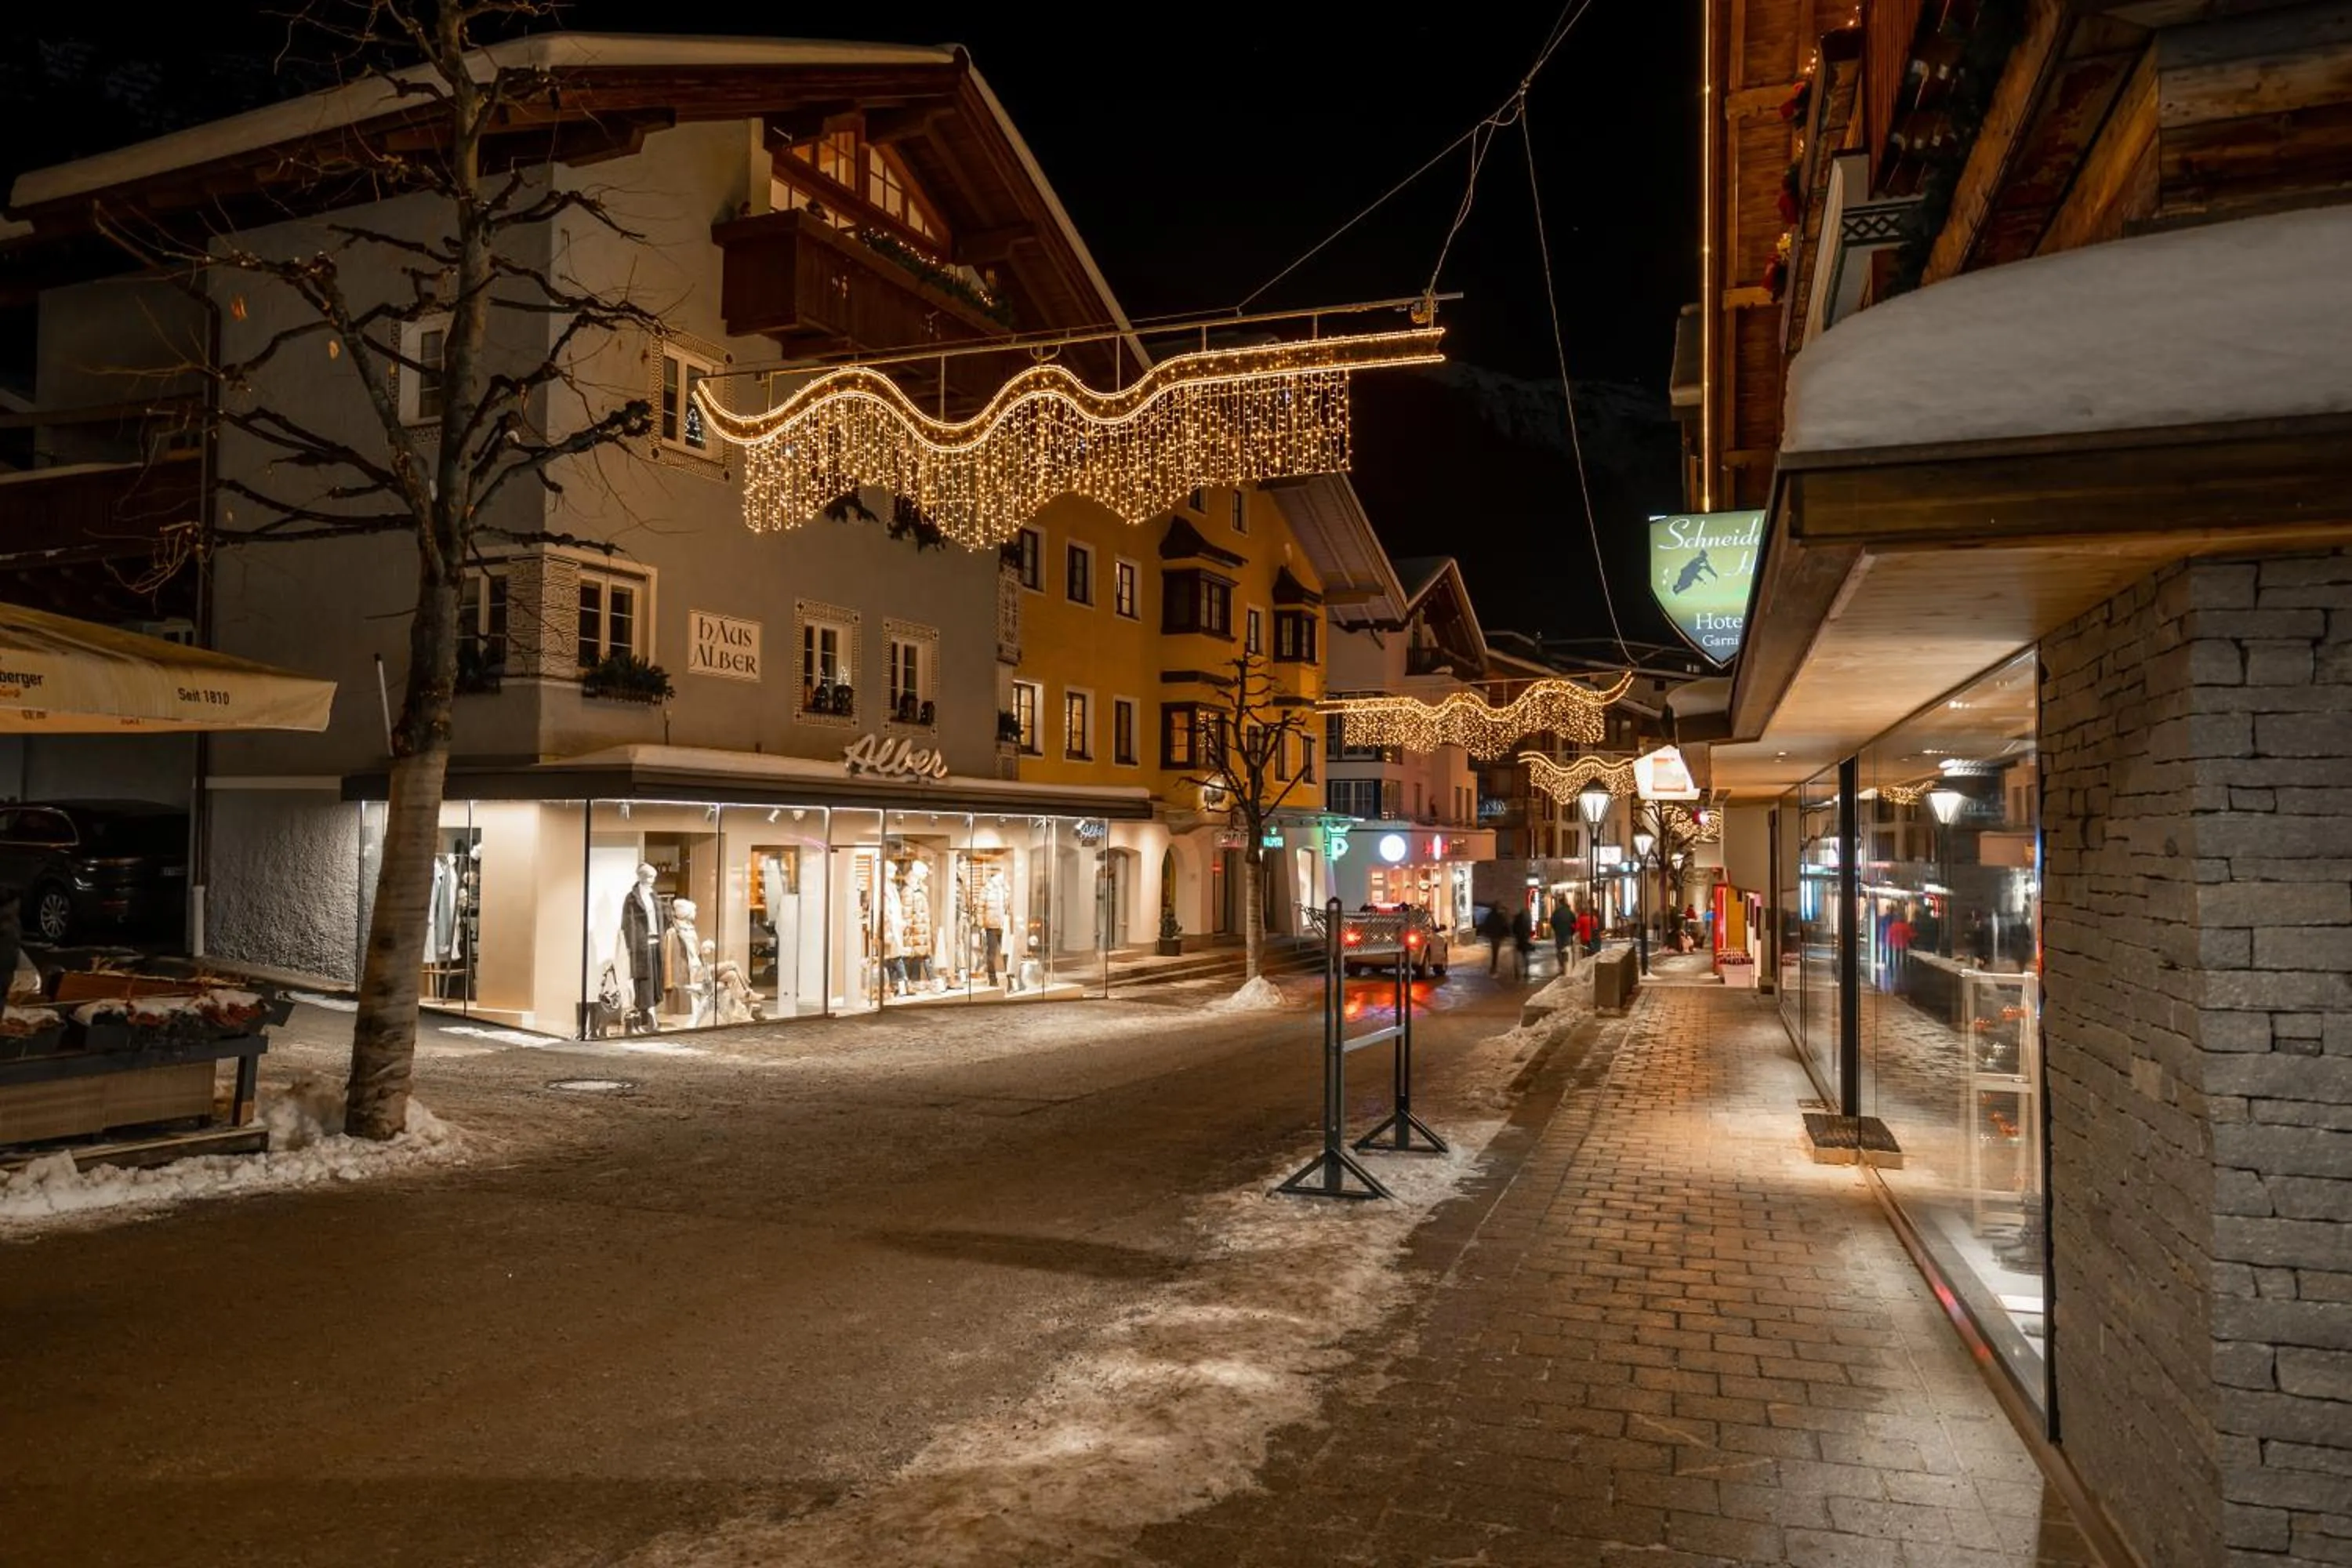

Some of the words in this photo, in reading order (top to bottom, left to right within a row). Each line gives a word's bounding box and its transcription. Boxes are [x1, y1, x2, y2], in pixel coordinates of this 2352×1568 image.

[1696, 612, 1744, 630] Hote
[1702, 634, 1740, 647] Garni
[691, 644, 757, 675] ALBER
[177, 687, 201, 702] Seit
[203, 689, 230, 706] 1810
[844, 733, 948, 779] Alber
